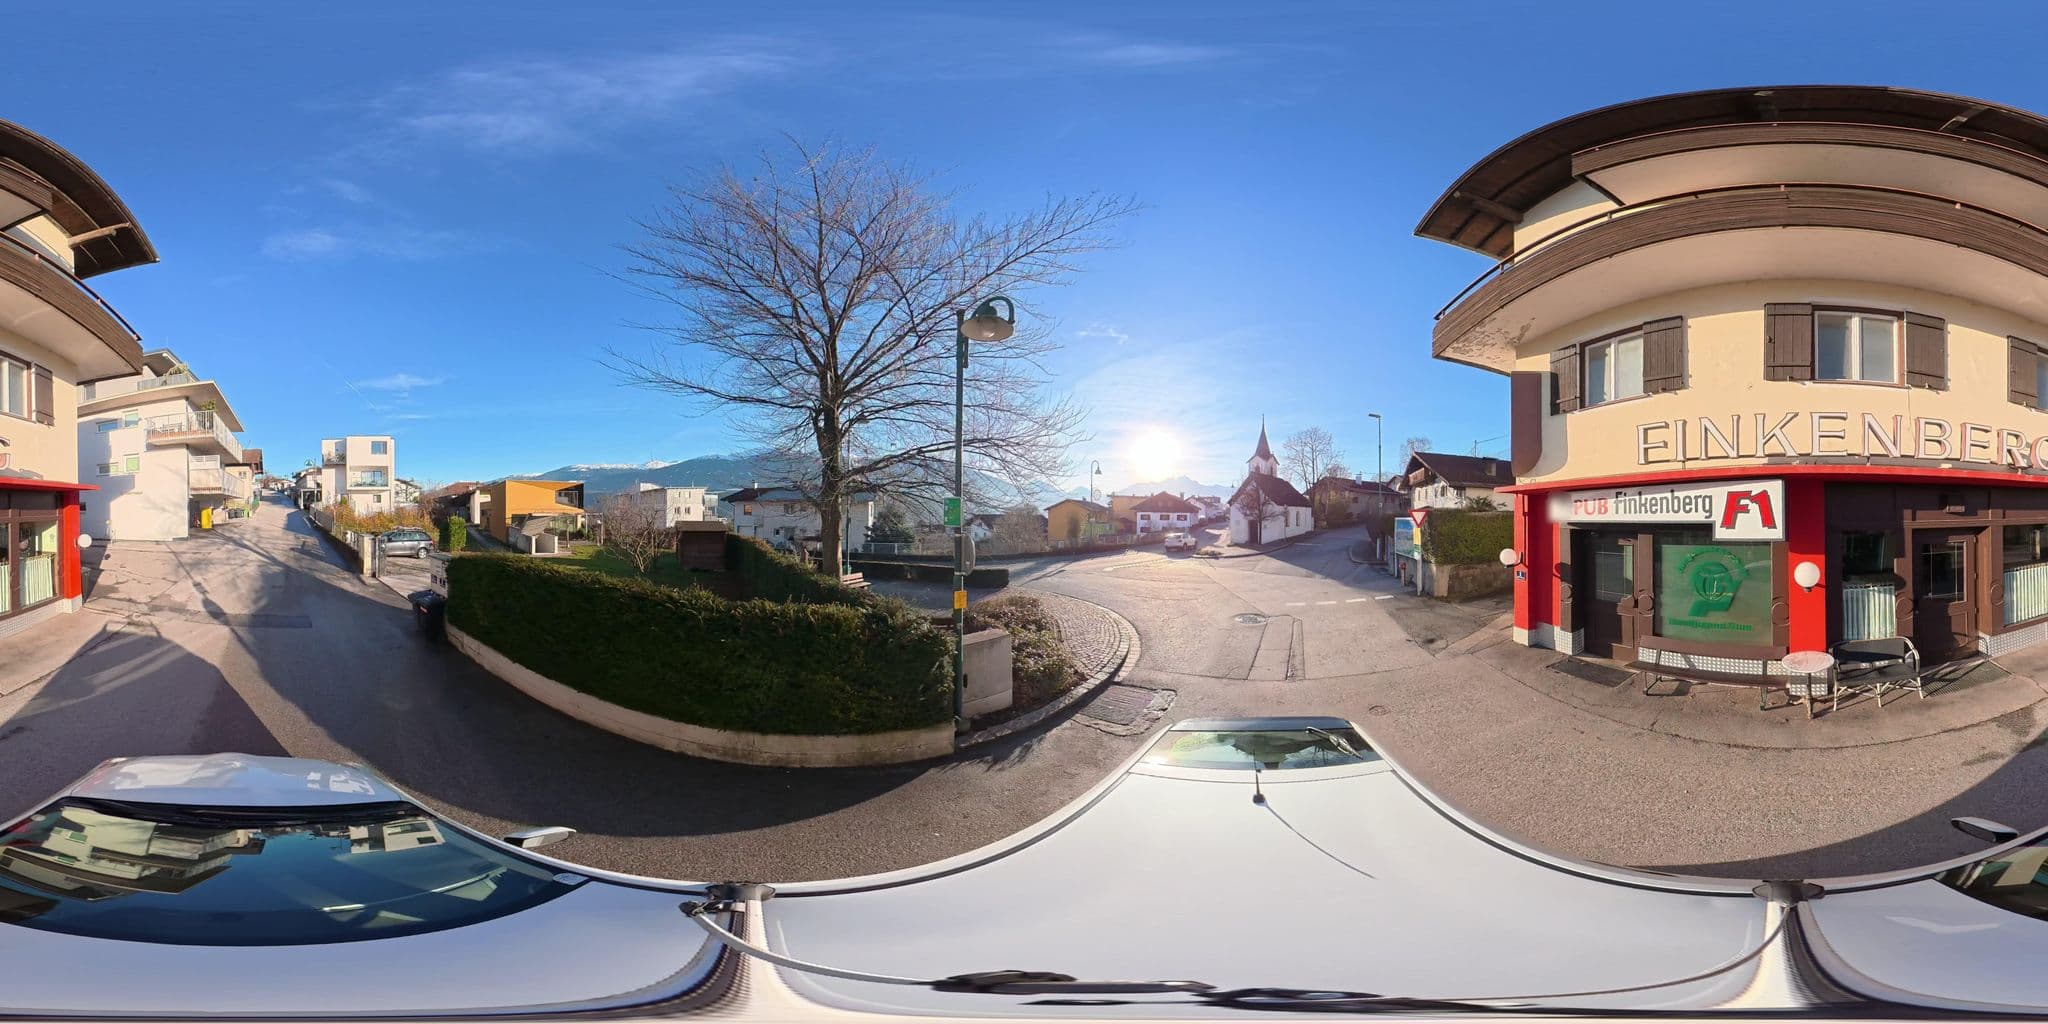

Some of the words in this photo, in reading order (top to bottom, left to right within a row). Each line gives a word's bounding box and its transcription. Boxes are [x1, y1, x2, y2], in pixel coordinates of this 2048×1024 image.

[1573, 498, 1608, 515] PUB
[1615, 489, 1713, 519] Finkenberg
[1720, 490, 1777, 529] F1
